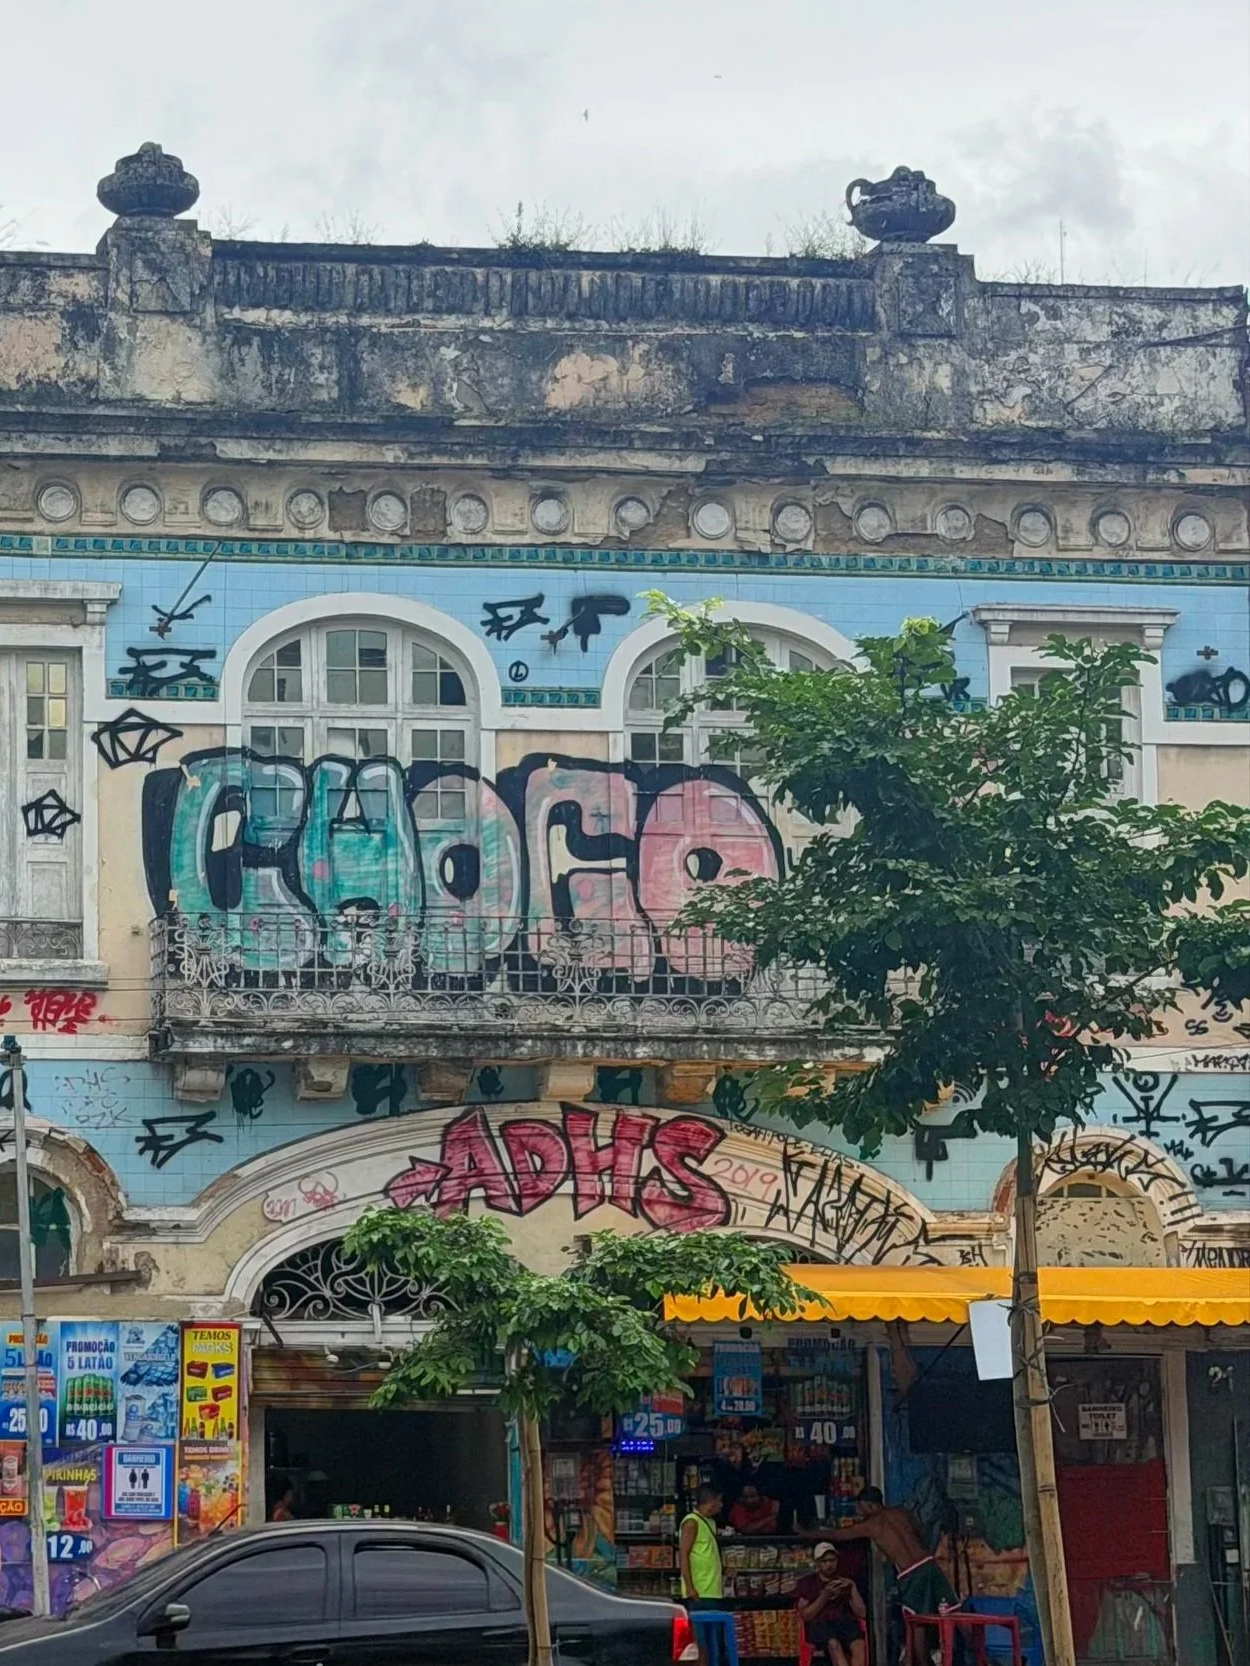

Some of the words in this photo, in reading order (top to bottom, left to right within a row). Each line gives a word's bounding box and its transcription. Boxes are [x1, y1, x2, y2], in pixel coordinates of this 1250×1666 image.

[432, 1097, 733, 1234] ADHS
[713, 1157, 779, 1200] 2019
[192, 1330, 232, 1341] TEMOS
[66, 1339, 115, 1355] PROMOÇÃO
[5, 1348, 17, 1368] 5
[17, 1350, 53, 1368] LÃO
[67, 1358, 75, 1369] 5
[78, 1355, 113, 1370] LATÃO
